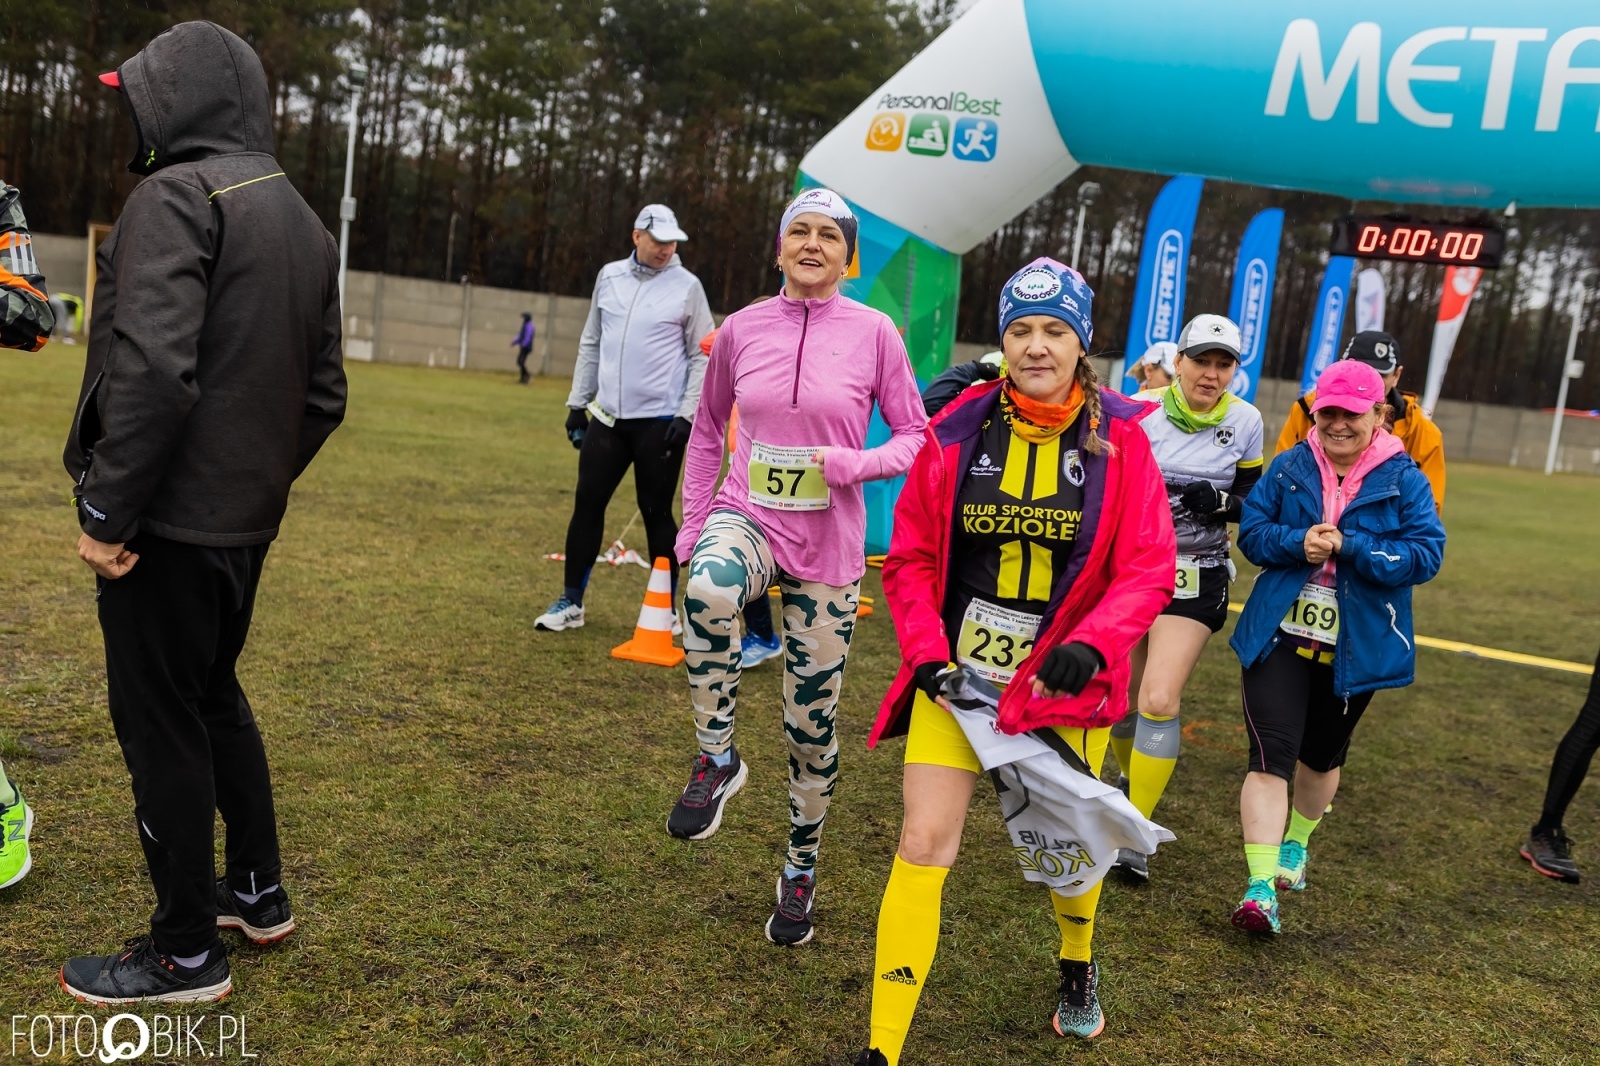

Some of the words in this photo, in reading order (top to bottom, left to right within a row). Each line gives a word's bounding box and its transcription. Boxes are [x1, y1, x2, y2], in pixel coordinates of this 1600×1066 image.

[877, 92, 1002, 116] PersonalBest
[1358, 226, 1484, 260] 0:00:00
[1152, 240, 1178, 340] RAFAMET
[766, 467, 806, 497] 57
[963, 504, 997, 515] KLUB
[963, 516, 1080, 541] KOZIOŁE
[1290, 602, 1337, 632] 169
[881, 972, 918, 986] adidas
